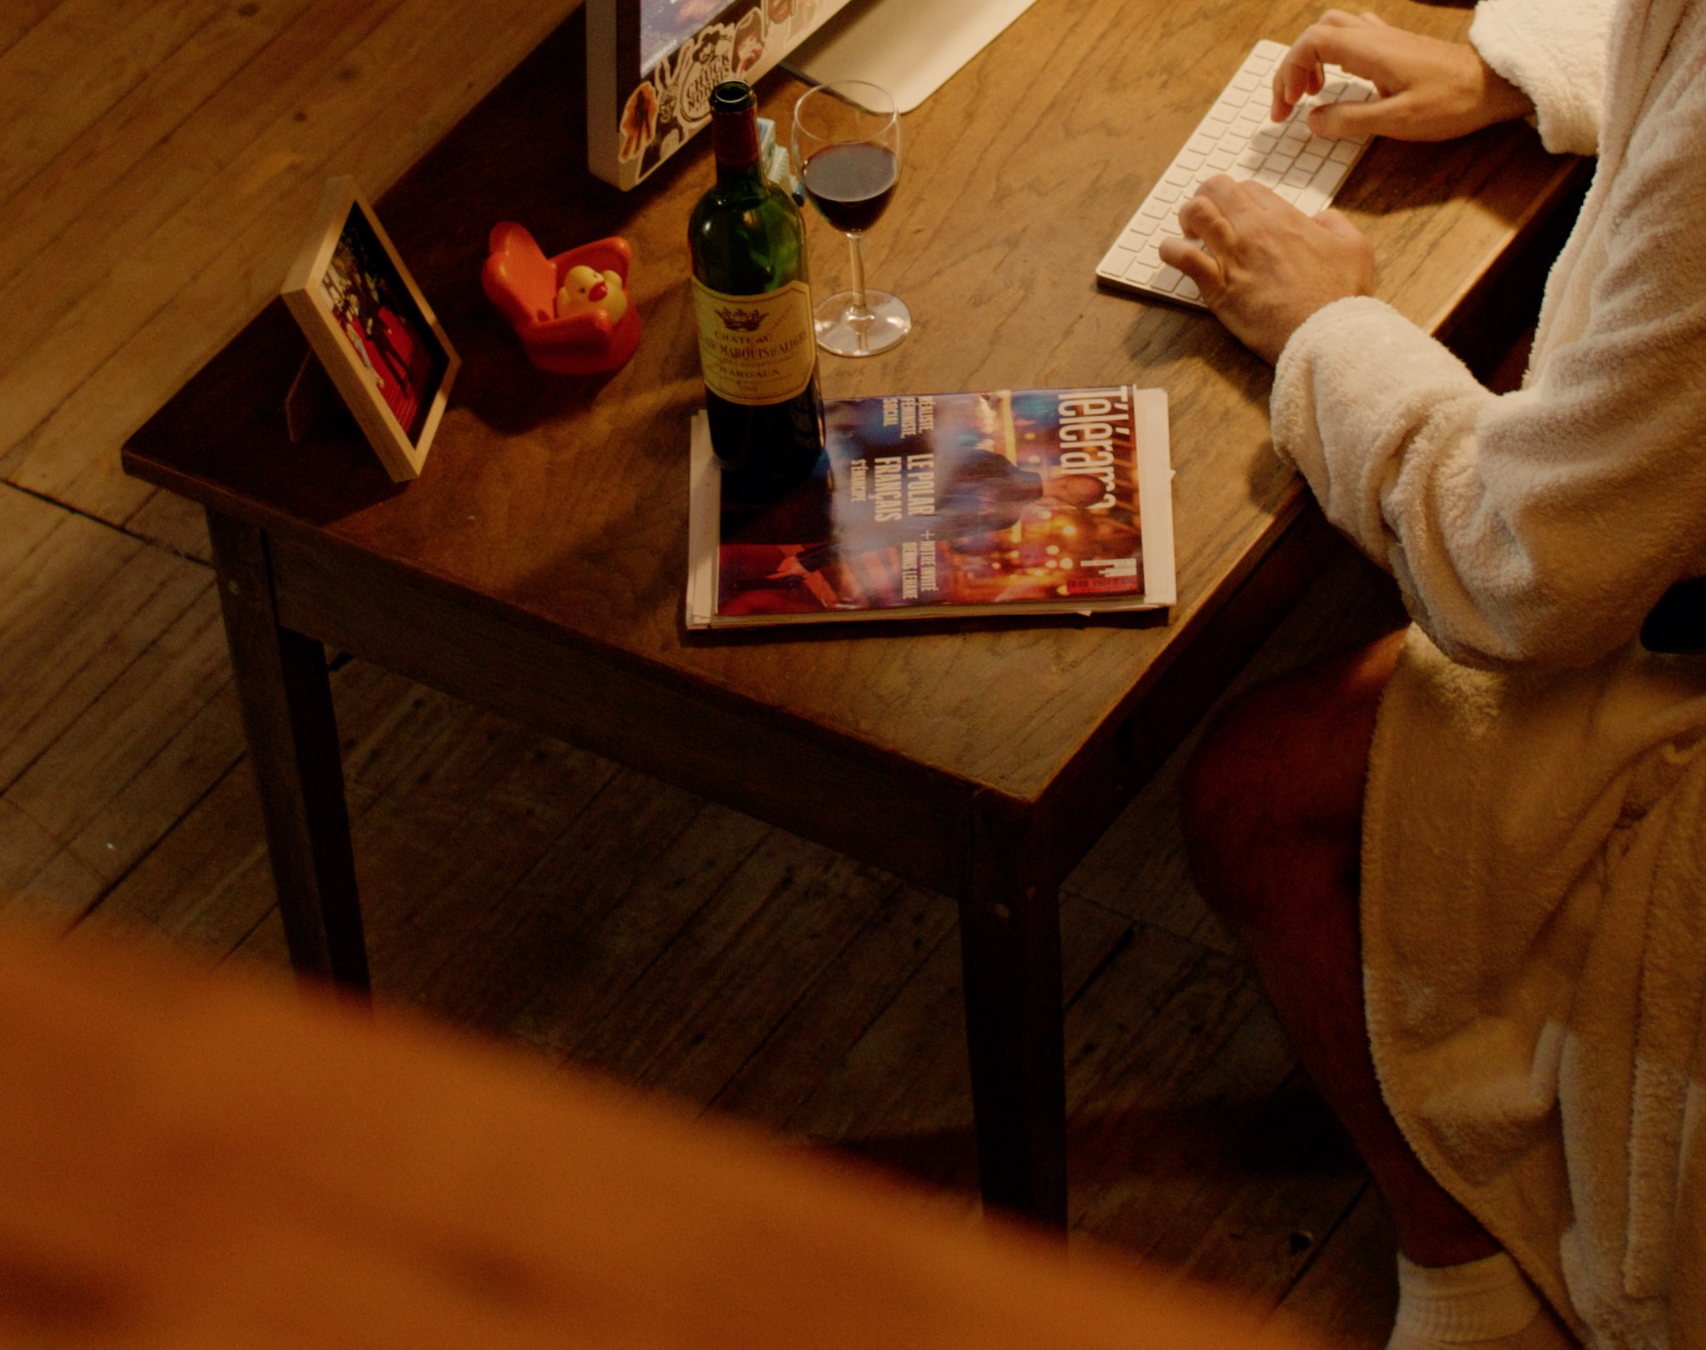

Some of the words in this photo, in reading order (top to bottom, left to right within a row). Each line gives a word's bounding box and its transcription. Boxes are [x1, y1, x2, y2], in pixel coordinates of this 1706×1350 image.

[686, 53, 730, 98] CHUCK
[882, 398, 899, 427] SOCIAL
[907, 453, 935, 470] LE
[869, 457, 903, 522] FRANÇAIS
[907, 471, 936, 515] POLAR
[920, 541, 937, 565] NOTRE
